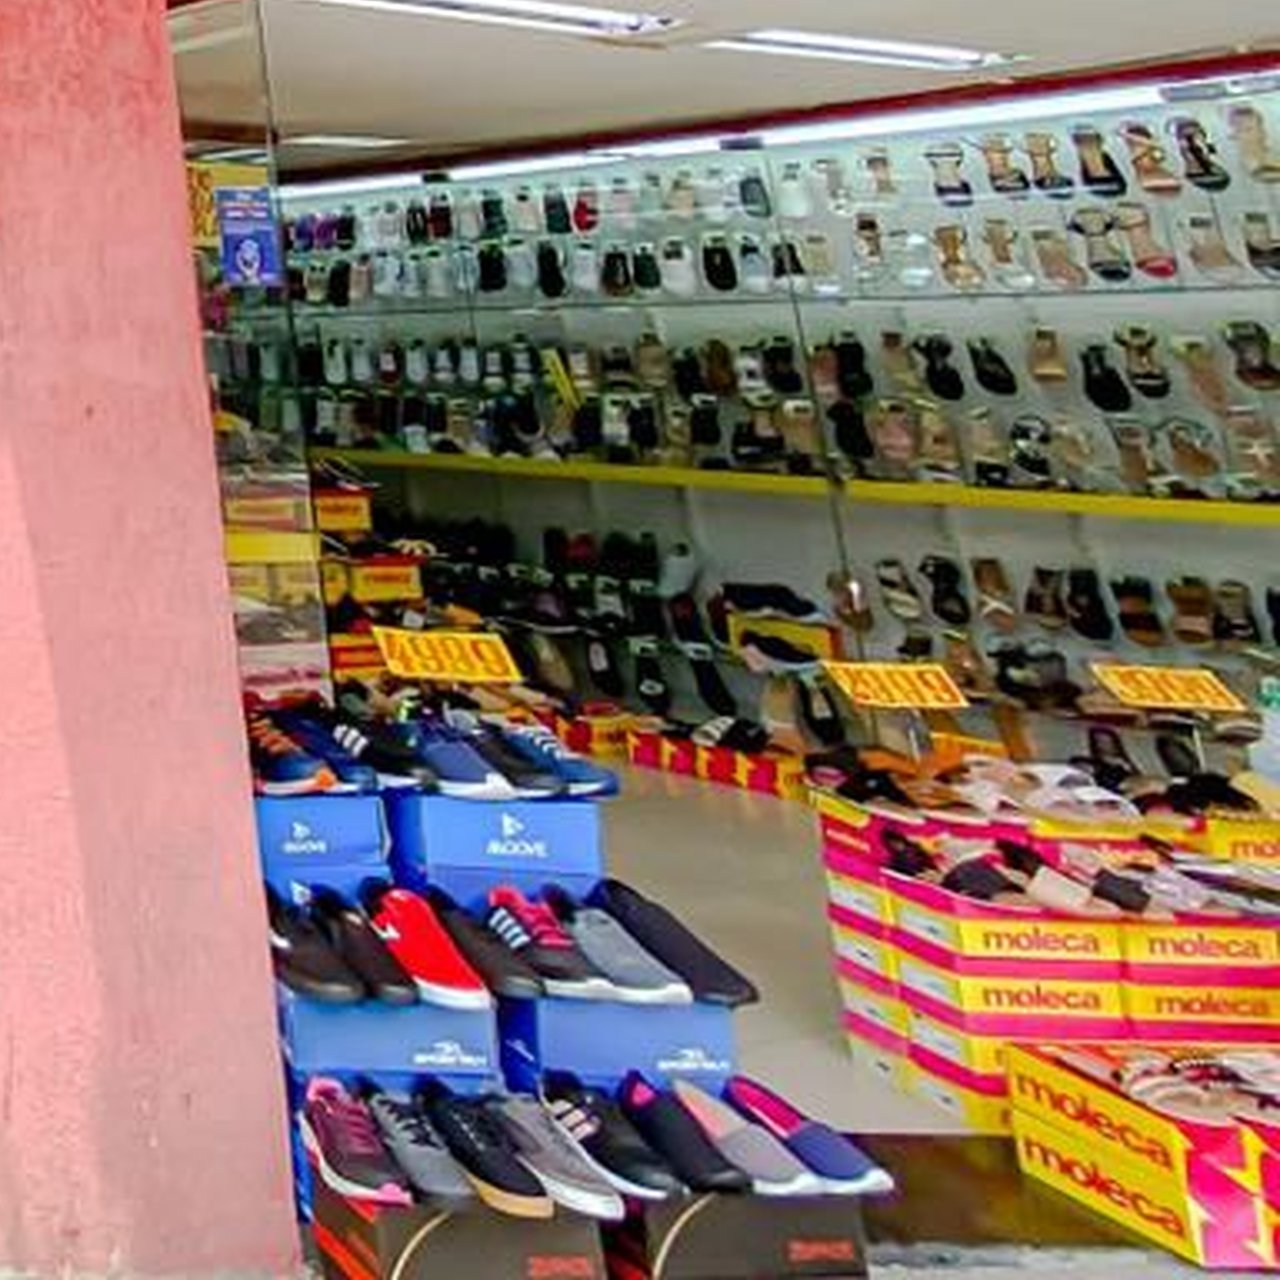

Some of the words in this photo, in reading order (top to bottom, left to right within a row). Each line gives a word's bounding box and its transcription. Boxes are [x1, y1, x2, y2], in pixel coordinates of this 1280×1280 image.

[982, 926, 1101, 953] moleca
[1149, 933, 1263, 959] moleca
[982, 985, 1101, 1011] moleca
[1155, 992, 1271, 1017] moleca
[1017, 1073, 1174, 1172] moleca
[1024, 1136, 1186, 1240] moleca
